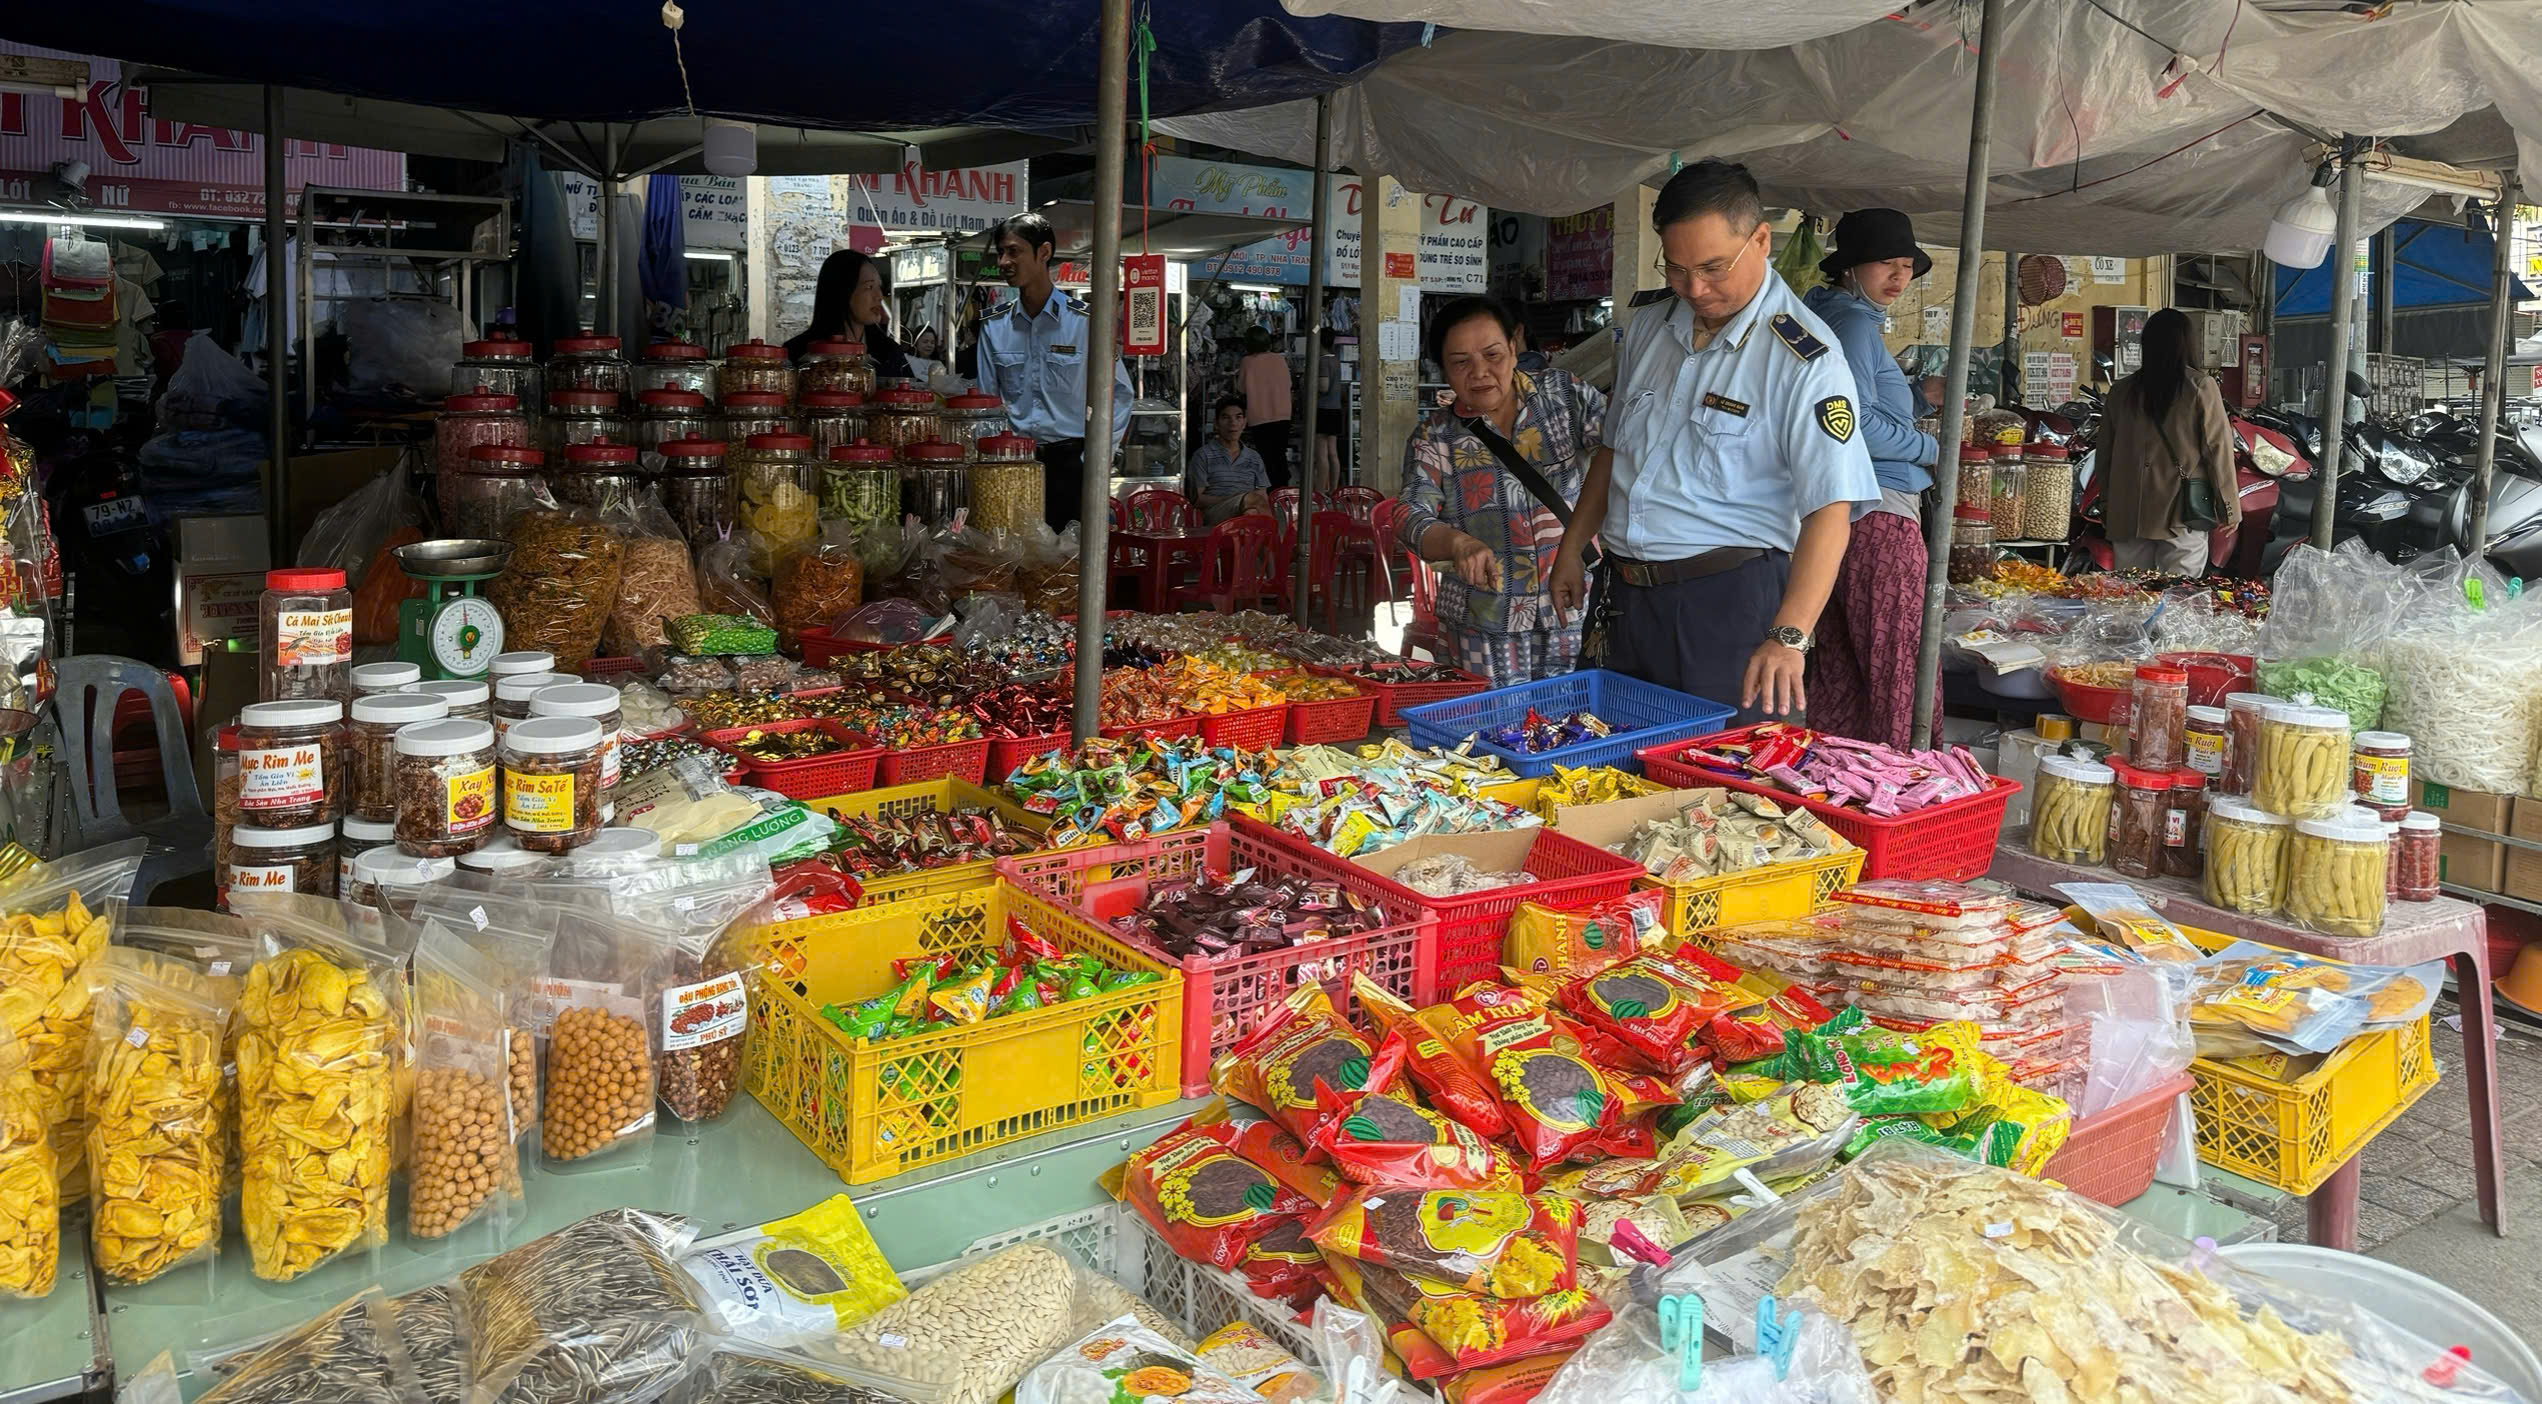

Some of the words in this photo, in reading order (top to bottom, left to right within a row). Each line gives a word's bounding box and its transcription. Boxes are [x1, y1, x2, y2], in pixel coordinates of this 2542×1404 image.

[893, 160, 1016, 207] KHANH
[183, 203, 265, 214] www.facebook.co
[856, 203, 888, 223] Quần
[891, 207, 906, 220] Áo
[1336, 229, 1361, 242] Chuyê
[1450, 237, 1466, 248] CAO
[1467, 235, 1483, 249] CẤP
[1466, 272, 1484, 284] C71
[286, 614, 298, 627] Cá
[300, 614, 320, 627] Mai
[263, 754, 289, 770] Rim
[293, 750, 315, 767] Me
[458, 780, 482, 794] Xay
[515, 777, 535, 793] Rim
[270, 798, 288, 807] Nha
[289, 794, 312, 804] Trang
[238, 871, 260, 887] Rim
[263, 870, 286, 887] Me
[1554, 913, 1569, 969] HANH
[1442, 1009, 1488, 1041] LÂM
[1483, 994, 1541, 1020] THAN
[1835, 1050, 1857, 1084] LONG
